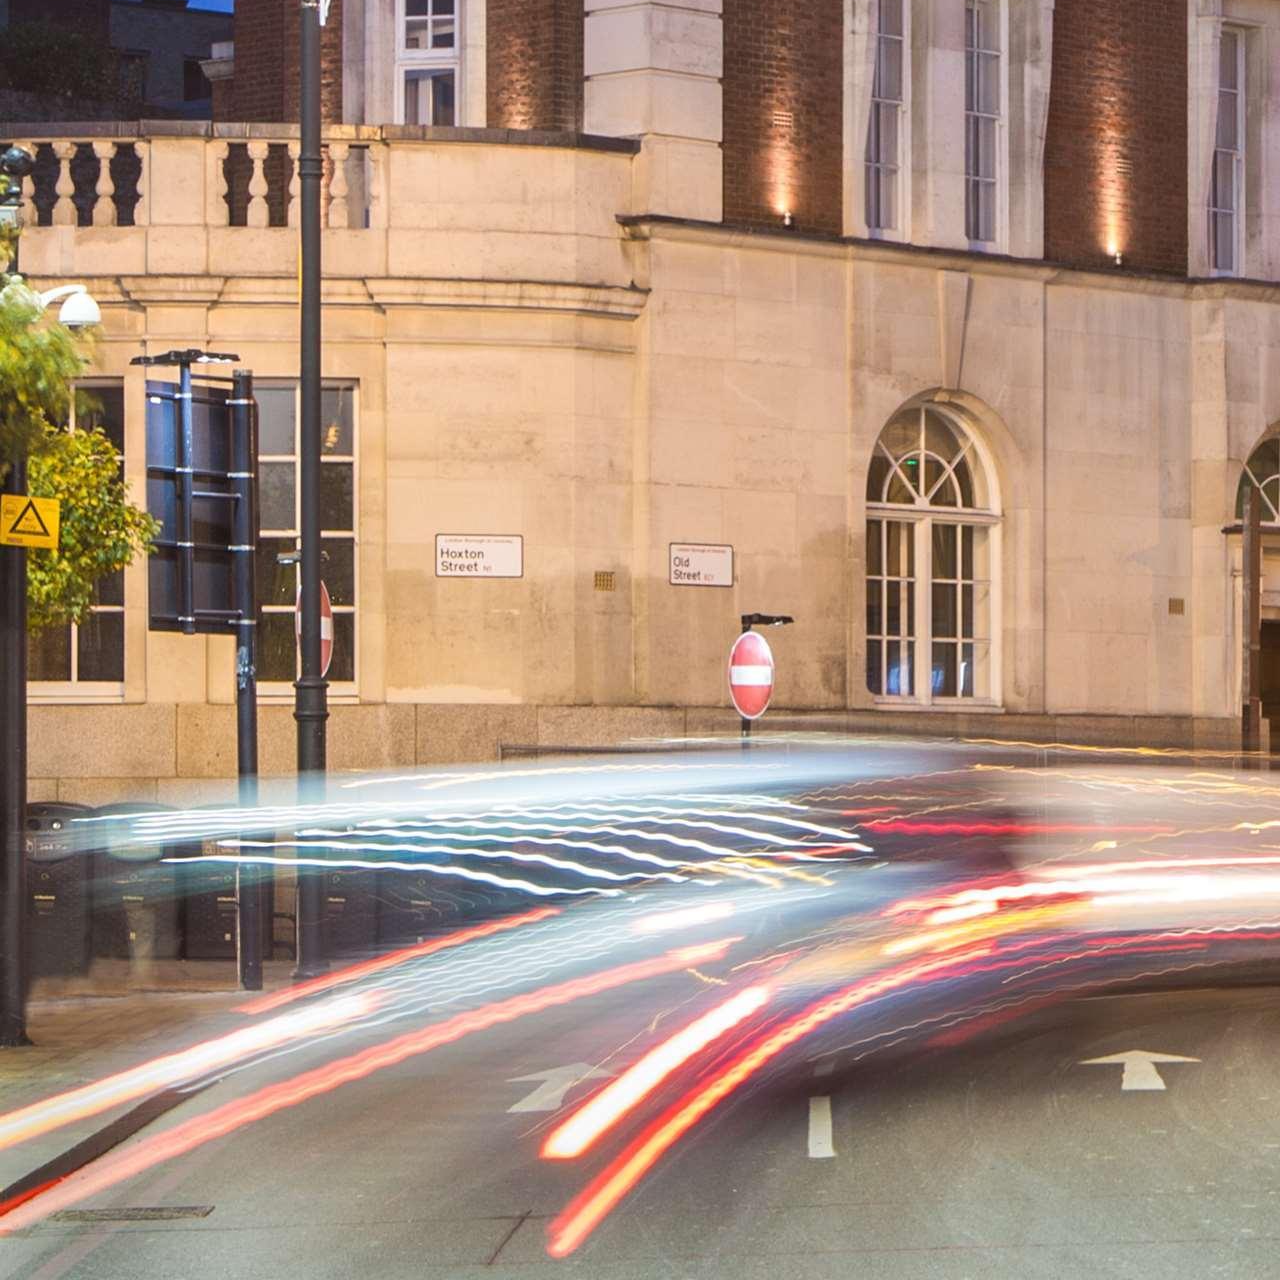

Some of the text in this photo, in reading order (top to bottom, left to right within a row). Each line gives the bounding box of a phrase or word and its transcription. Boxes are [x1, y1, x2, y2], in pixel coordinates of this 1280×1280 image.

[440, 548, 484, 559] Hoxton
[441, 561, 478, 572] Street
[673, 556, 690, 568] Old
[673, 569, 701, 580] Street
